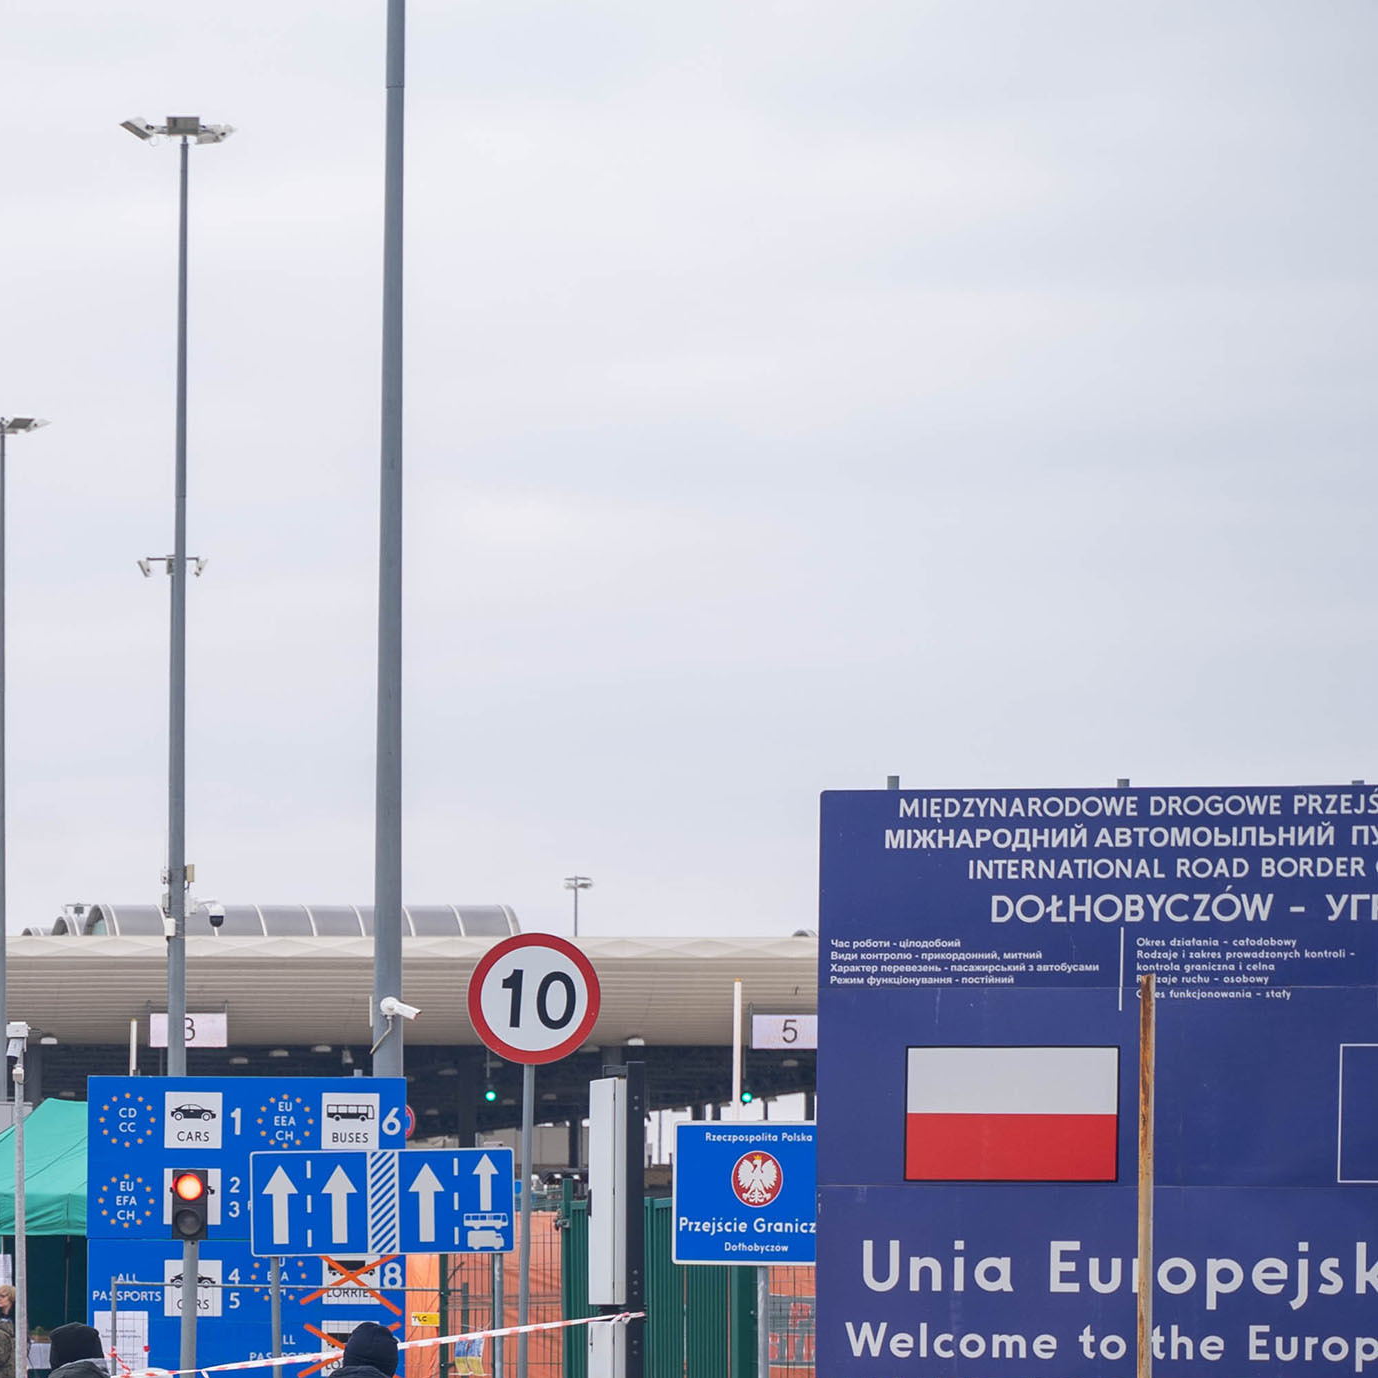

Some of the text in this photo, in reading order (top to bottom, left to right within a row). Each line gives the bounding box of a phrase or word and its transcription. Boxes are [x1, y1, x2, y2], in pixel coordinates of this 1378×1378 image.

[898, 796, 1138, 823] MIĘDZYNARODOWE
[1149, 795, 1282, 816] DROGOWE
[884, 823, 1087, 852] МІЖНАРОДНИЙ
[968, 857, 1366, 880] INTERNATIONAL ROAD BORDER
[990, 884, 1274, 923] DOŁHOBYCZÓW
[830, 939, 850, 948] Час
[852, 938, 891, 950] роботи
[1136, 937, 1166, 947] Okres
[1170, 937, 1219, 947] działania
[1232, 937, 1297, 948] całodobowy
[830, 951, 858, 961] Види
[860, 952, 913, 961] контролю
[921, 951, 1001, 961] прикордонний,
[1003, 950, 1042, 960] митний
[1136, 949, 1178, 960] Rodzaje
[1182, 949, 1185, 958] i
[1189, 949, 1222, 959] zakres
[1225, 949, 1301, 960] prowadzonych
[1304, 948, 1346, 958] kontroli
[830, 963, 878, 974] Характер
[880, 964, 942, 974] перевезень
[950, 963, 1026, 974] пасажирський
[1036, 962, 1100, 973] автобусами
[1136, 962, 1275, 973] kontrola graniczna i celna
[830, 975, 864, 985] Режим
[866, 975, 953, 986] функціонування
[961, 975, 1015, 984] постійний
[1136, 974, 1178, 985] Rzaje
[1181, 974, 1210, 983] ruchu
[1223, 974, 1269, 985] osobowy
[501, 968, 577, 1030] 10
[1136, 989, 1165, 999] Oes
[1170, 989, 1252, 1000] funkcjonowania
[781, 1019, 798, 1043] 5
[118, 1107, 137, 1118] CD
[278, 1101, 293, 1112] EU
[230, 1107, 242, 1135] 1
[273, 1116, 296, 1127] EEA
[381, 1107, 402, 1136] 6
[118, 1122, 137, 1133] CC
[176, 1131, 210, 1142] CARS
[275, 1130, 294, 1141] CH
[331, 1132, 369, 1143] BUSES
[705, 1132, 813, 1144] Rzeczpospolita Polska
[119, 1181, 135, 1192] EU
[229, 1176, 241, 1193] 2
[116, 1210, 136, 1221] CH
[228, 1201, 240, 1218] 3
[678, 1216, 816, 1236] Przejście Granicz
[862, 1239, 1014, 1292] Unia
[117, 1273, 138, 1283] ALL
[228, 1268, 241, 1285] 4
[383, 1262, 403, 1287] 8
[326, 1288, 375, 1298] LORRIE
[176, 1299, 210, 1310] CRS
[228, 1292, 241, 1309] 5
[283, 1334, 296, 1345] LL
[845, 1321, 1057, 1359] Welcome
[1078, 1324, 1127, 1361] to
[1151, 1324, 1225, 1361] the
[1249, 1325, 1378, 1372] Europ
